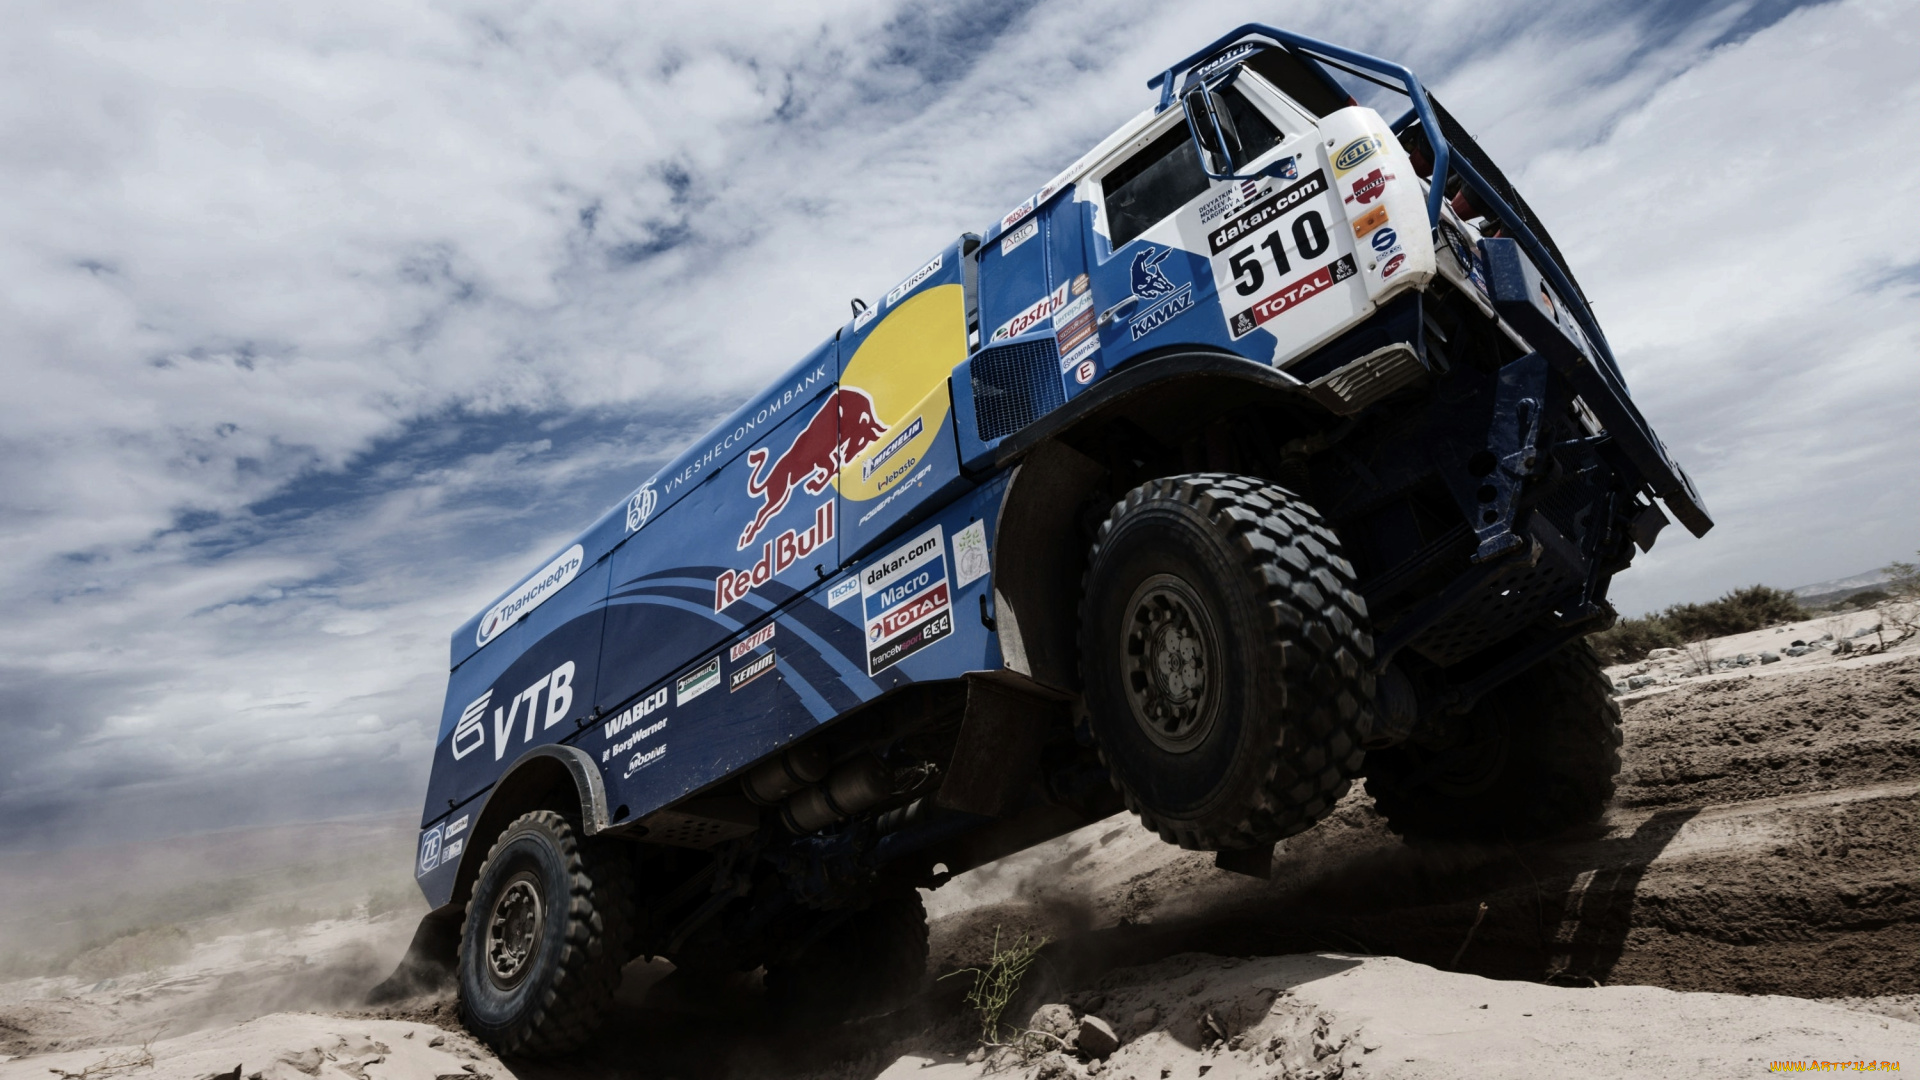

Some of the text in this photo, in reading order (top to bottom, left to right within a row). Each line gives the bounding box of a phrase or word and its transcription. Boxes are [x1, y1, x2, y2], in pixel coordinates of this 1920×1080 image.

[1199, 188, 1233, 213] DEVYATKIN
[1200, 200, 1225, 219] MOKEEV
[1201, 201, 1234, 225] KARGINOV
[1215, 179, 1320, 247] dakar.com
[1229, 210, 1330, 297] 510
[1009, 288, 1064, 338] Castrol
[1131, 289, 1195, 341] KAMAZ
[1255, 277, 1330, 317] TOTAL
[1079, 363, 1092, 380] E
[665, 364, 825, 494] VNESHECONOMBANK
[873, 420, 921, 469] MICHELIN
[715, 497, 835, 615] Red Bull
[867, 537, 937, 585] dakar.com
[500, 557, 580, 621] Транснефть
[831, 579, 857, 600] TECHO
[880, 572, 929, 609] Macro
[885, 594, 946, 631] TOTAL
[732, 624, 774, 660] LOCTITE
[494, 660, 576, 762] VTB
[604, 686, 668, 740] WABCO
[612, 717, 668, 757] BorgWarner
[628, 743, 667, 772] MODINE
[423, 834, 440, 865] ZF
